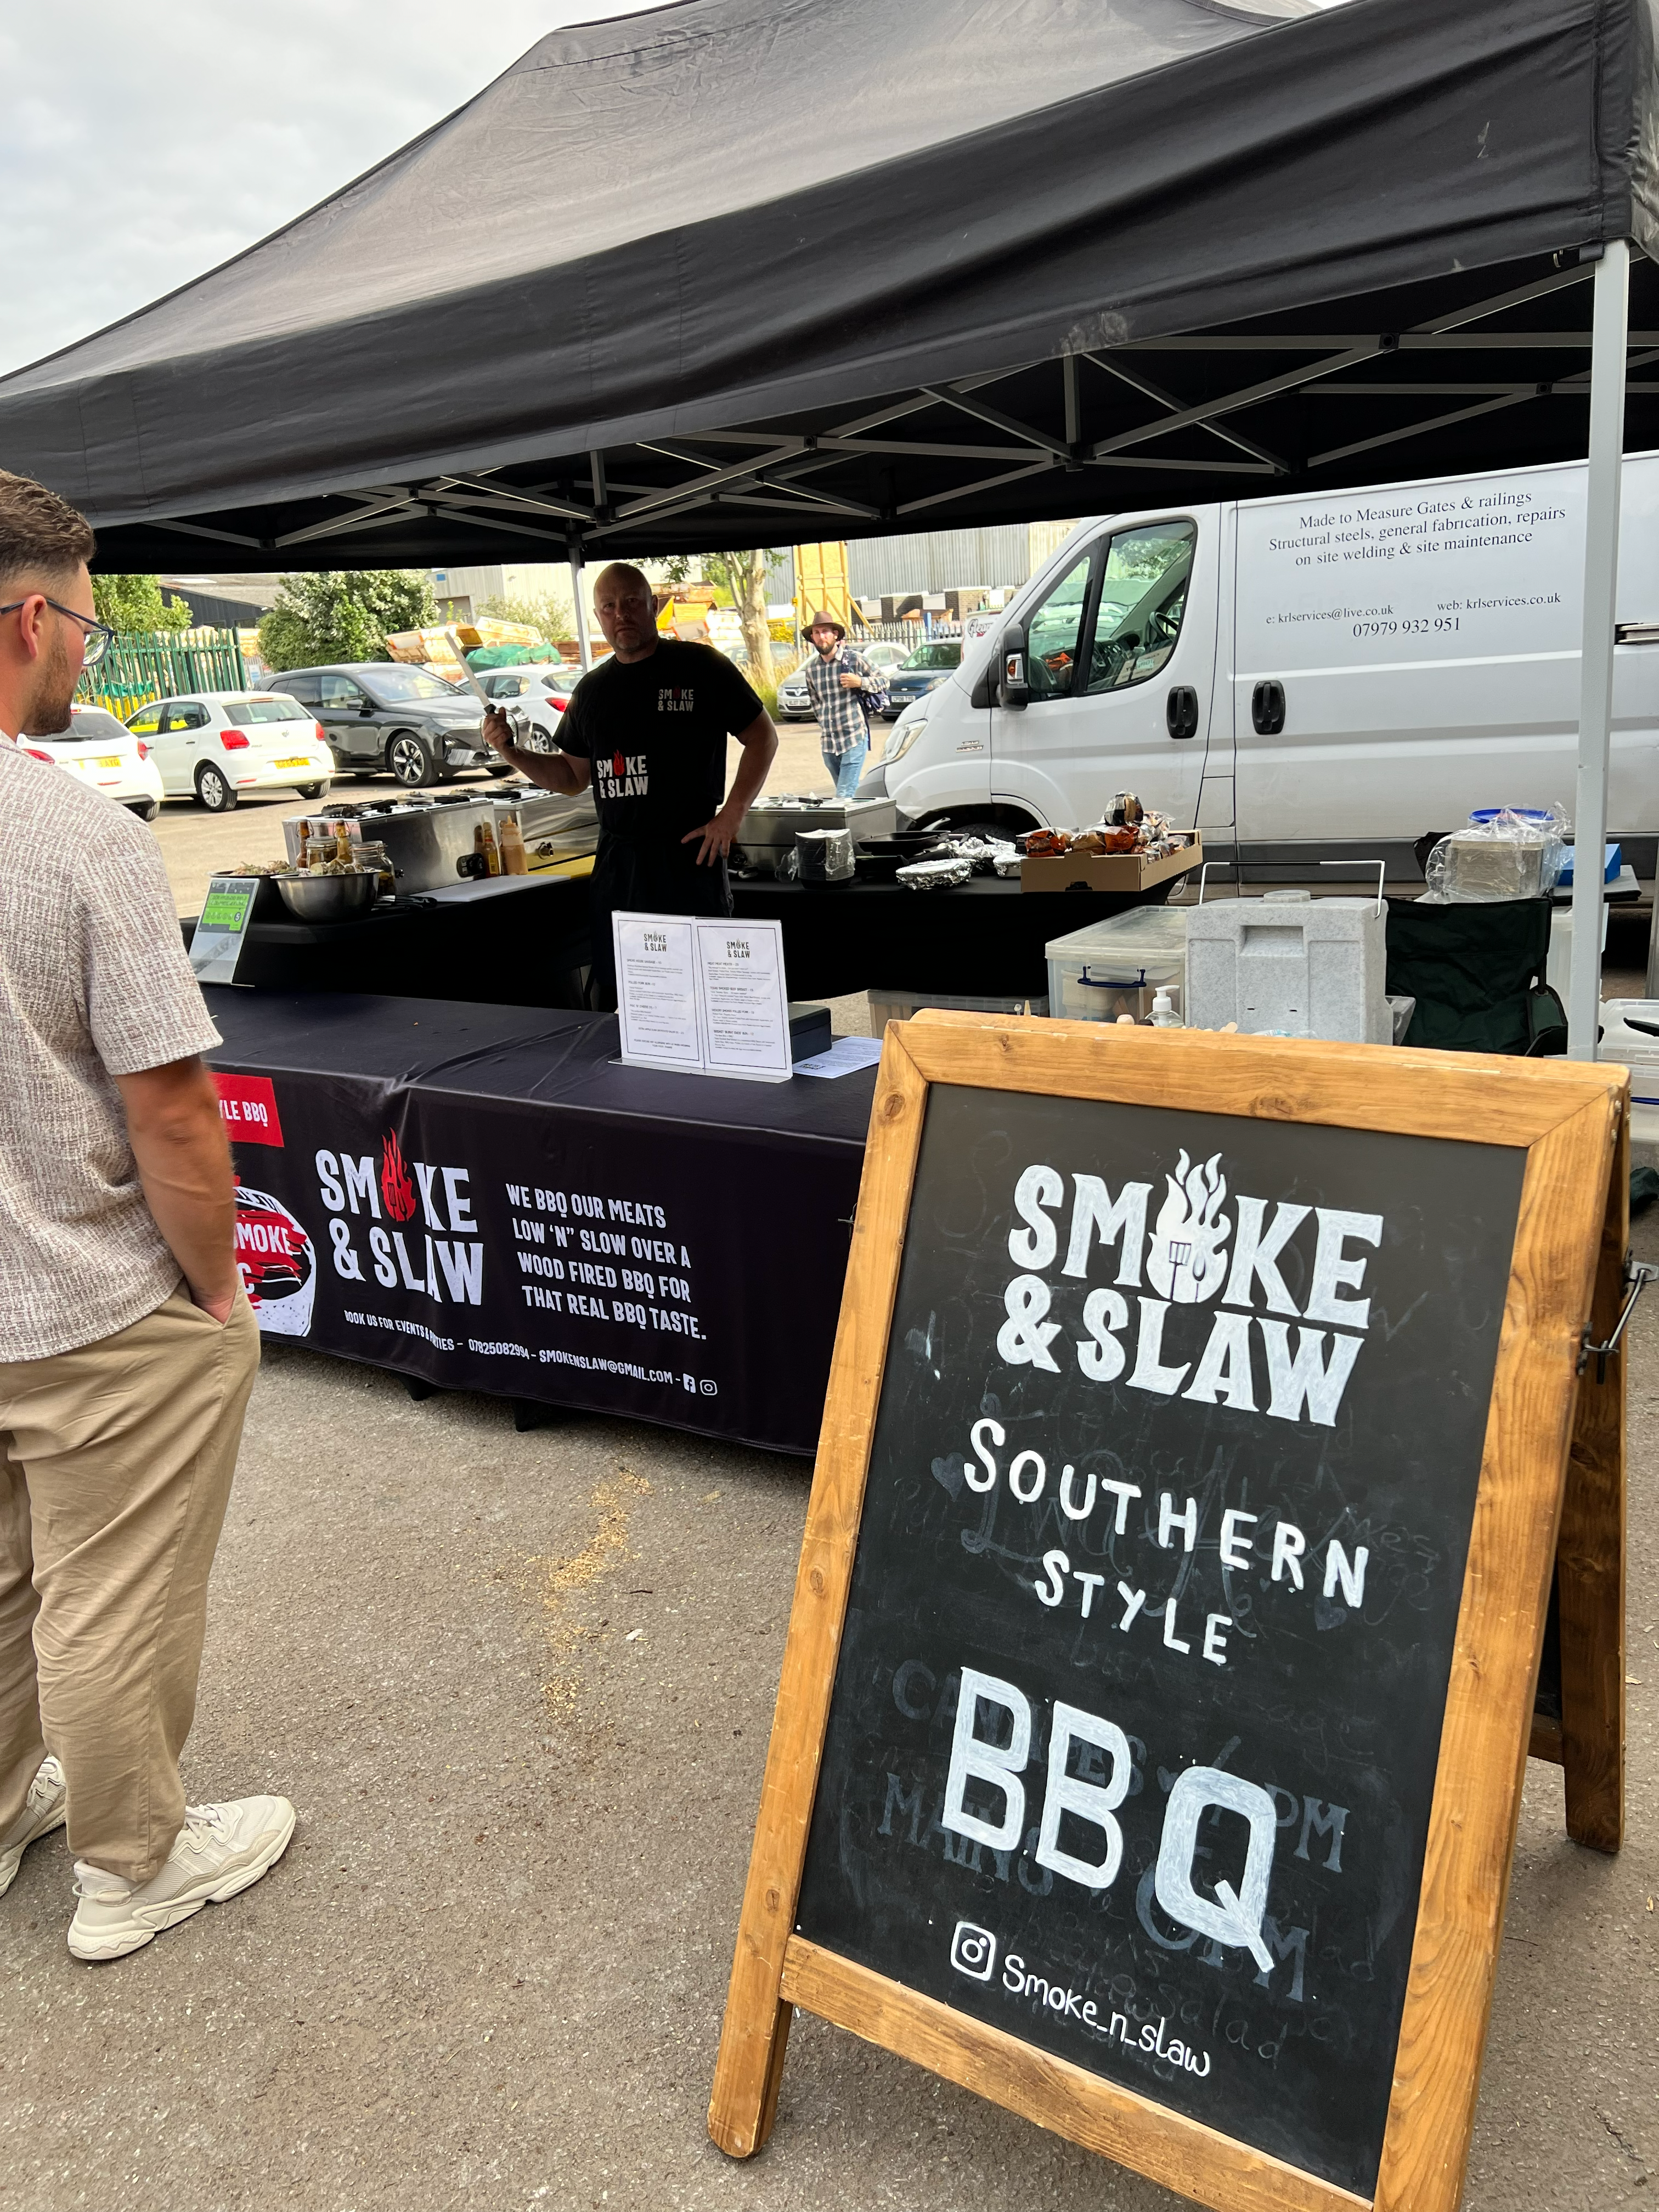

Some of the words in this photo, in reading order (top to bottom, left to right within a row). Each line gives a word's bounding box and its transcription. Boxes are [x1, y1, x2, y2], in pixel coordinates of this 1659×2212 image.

[1269, 532, 1329, 550] Structural
[1335, 528, 1374, 542] steels,
[1379, 520, 1427, 540] general
[1434, 514, 1511, 531] fabrication,
[1517, 507, 1565, 524] repairs
[1300, 514, 1335, 528] Made
[1340, 515, 1351, 523] to
[1357, 507, 1412, 521] Measure
[1418, 502, 1455, 514] Gates
[1462, 496, 1473, 509] &
[1480, 493, 1531, 507] railings
[1296, 557, 1310, 565] on
[1317, 552, 1338, 563] site
[1344, 546, 1394, 560] welding
[1400, 543, 1410, 554] &
[1417, 540, 1439, 552] site
[1444, 533, 1532, 549] maintenance
[1279, 605, 1393, 623] krlservices@live.co.uk
[1437, 600, 1462, 610] web:
[1467, 593, 1560, 608] krlservices.co.uk
[1353, 622, 1397, 636] 07979
[1403, 619, 1428, 633] 932
[1435, 618, 1458, 631] 951
[658, 701, 664, 711] &
[667, 701, 694, 712] SLAW
[600, 780, 606, 799] &
[608, 776, 648, 798] SLAW
[651, 943, 667, 952] SLAW
[241, 1101, 268, 1127] BBQ
[506, 1183, 532, 1208] WE
[535, 1188, 567, 1217] BBQ
[571, 1194, 605, 1219] OUR
[608, 1199, 666, 1228] MEATS
[329, 1217, 366, 1282] &
[369, 1226, 483, 1306] SLAW
[512, 1218, 544, 1243] LOW
[580, 1229, 625, 1255] SLOW
[631, 1237, 676, 1264] OVER
[681, 1246, 691, 1268] A
[517, 1252, 564, 1279] WOOD
[568, 1261, 617, 1288] FIRED
[622, 1269, 654, 1299] BBQ
[659, 1276, 691, 1302] FOR
[522, 1286, 562, 1311] THAT
[567, 1294, 609, 1319] REAL
[612, 1301, 646, 1329] BBQ
[649, 1307, 706, 1340] TASTE.
[366, 1314, 377, 1326] US
[378, 1317, 394, 1330] FOR
[395, 1319, 425, 1338] EVENTS
[425, 1327, 429, 1340] &
[469, 1339, 529, 1359] 07825082994
[539, 1350, 673, 1384] SMOKENSLAW@GMAIL.COM
[996, 1273, 1063, 1374] &
[1076, 1288, 1365, 1427] SLAW
[962, 1417, 1369, 1609] SOUTHERN
[1034, 1549, 1234, 1664] STYLE
[941, 1666, 1277, 1974] BBQ
